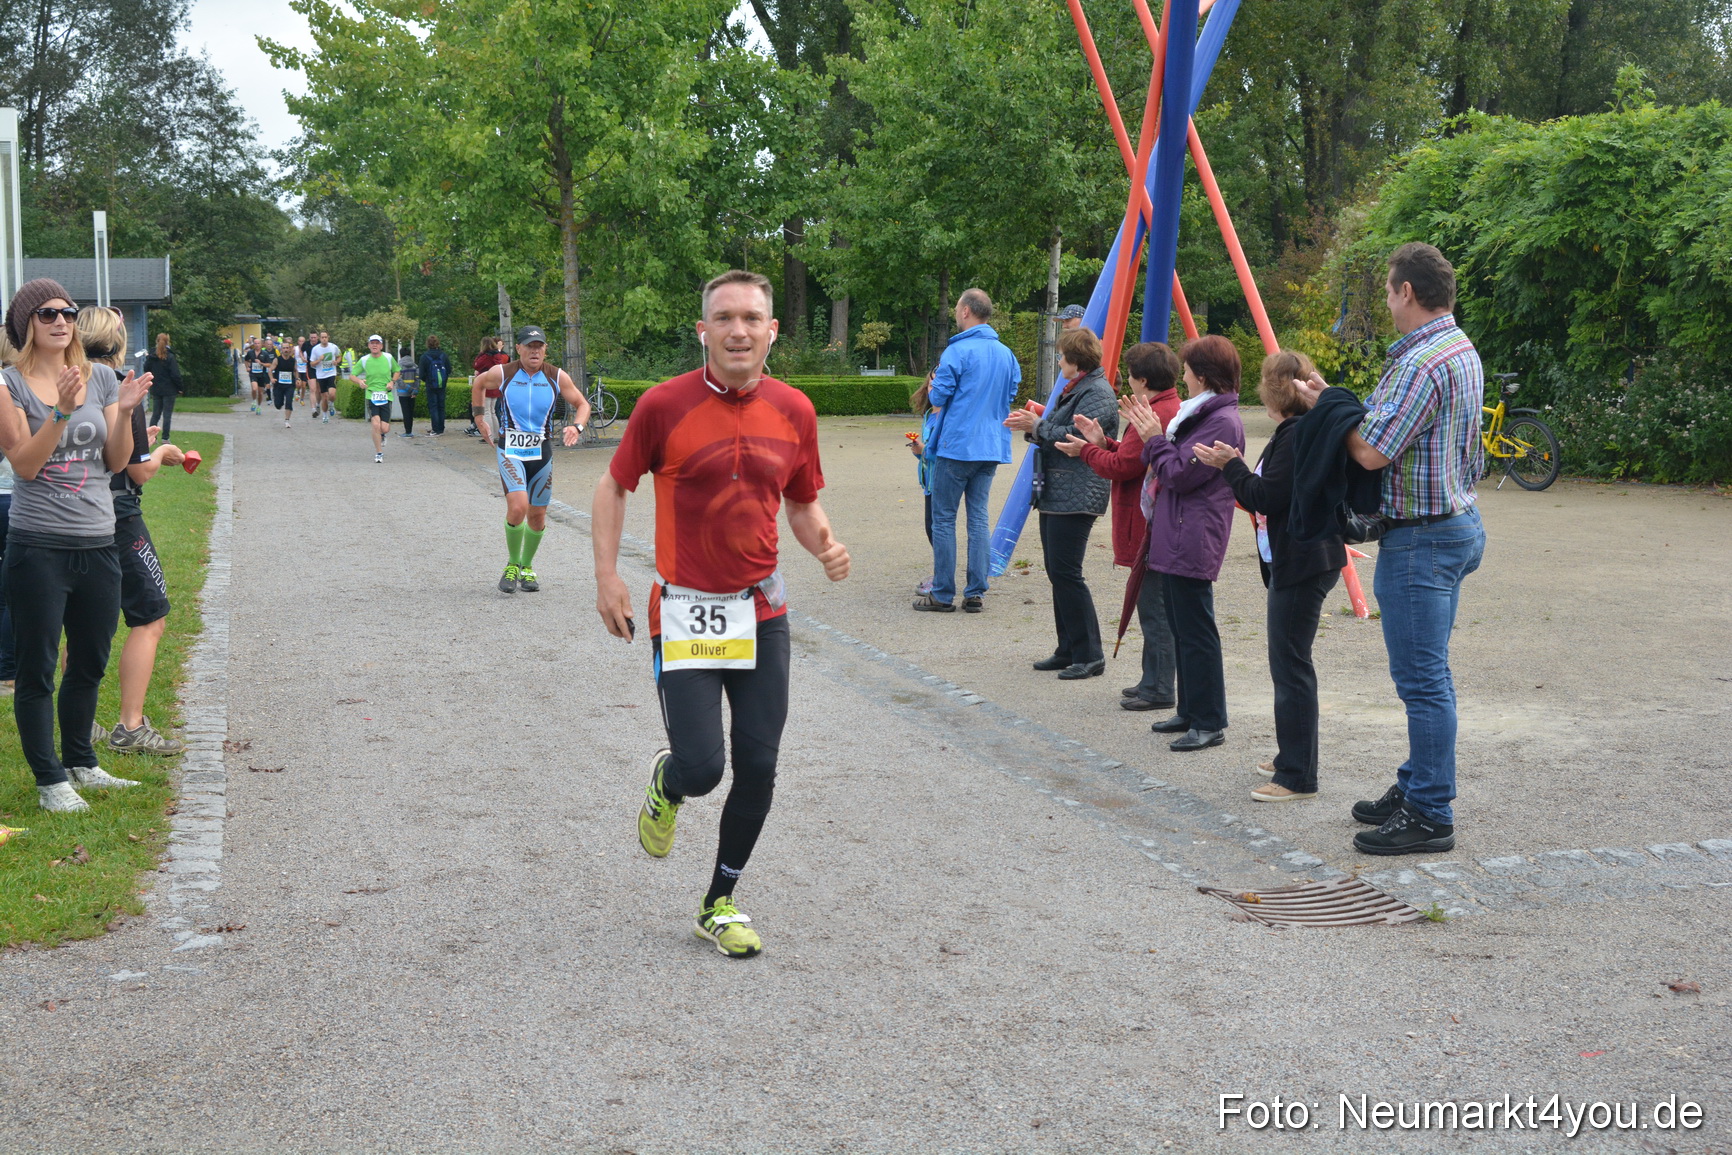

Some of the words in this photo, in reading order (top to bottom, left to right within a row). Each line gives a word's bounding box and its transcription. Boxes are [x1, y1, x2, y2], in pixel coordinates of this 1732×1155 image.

[509, 433, 541, 448] 2029
[695, 593, 738, 602] Neumarkt
[689, 604, 728, 636] 35
[690, 643, 728, 656] Oliver
